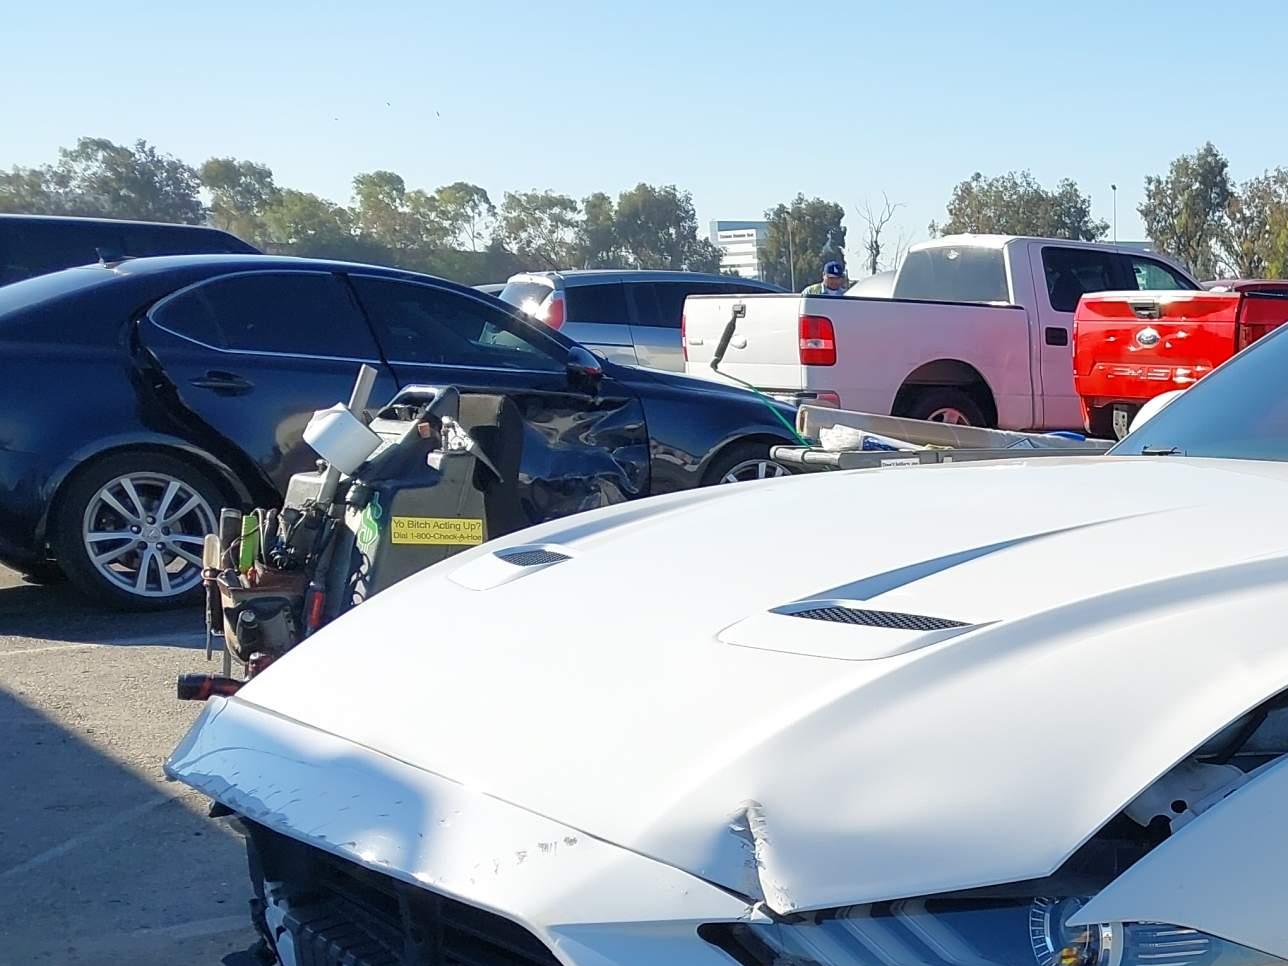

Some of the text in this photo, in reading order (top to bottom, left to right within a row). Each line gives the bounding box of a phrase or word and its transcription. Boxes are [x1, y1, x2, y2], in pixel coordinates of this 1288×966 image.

[393, 520, 481, 532] Yo Bitch Acting Up?
[393, 531, 408, 539] Dial
